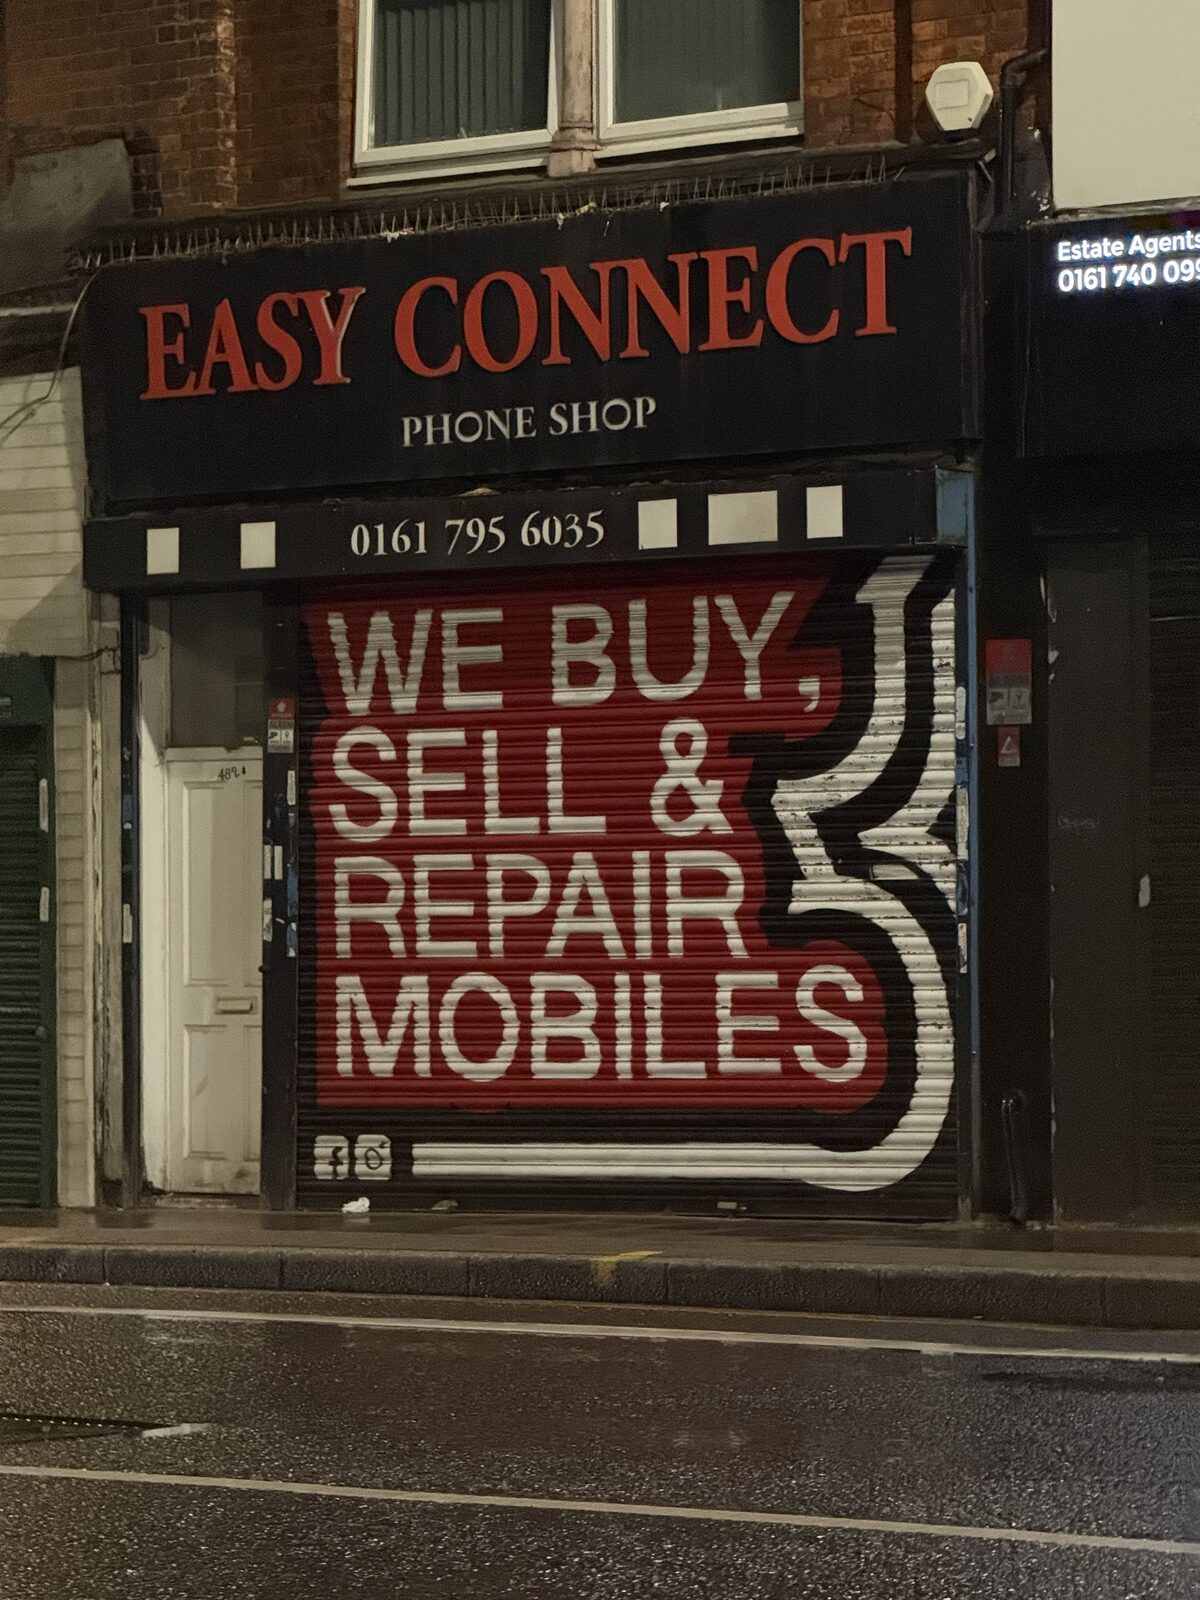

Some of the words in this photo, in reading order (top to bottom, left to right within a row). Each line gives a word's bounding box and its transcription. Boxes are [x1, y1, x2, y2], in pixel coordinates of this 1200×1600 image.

[1057, 238, 1125, 262] Estate
[1128, 230, 1200, 258] Agents
[1057, 264, 1108, 292] 0161
[1112, 262, 1157, 288] 740
[138, 286, 366, 400] EASY
[393, 226, 913, 378] CONNECT
[401, 406, 537, 448] PHONE
[549, 396, 657, 437] SHOP
[350, 521, 427, 556] 0161
[444, 515, 506, 555] 795
[521, 510, 605, 547] 6035
[327, 607, 504, 716] WE
[550, 590, 821, 713] BUY,
[328, 724, 607, 843] SELL
[650, 718, 734, 837] &
[333, 849, 750, 960] REPAIR
[335, 964, 869, 1083] MOBILES
